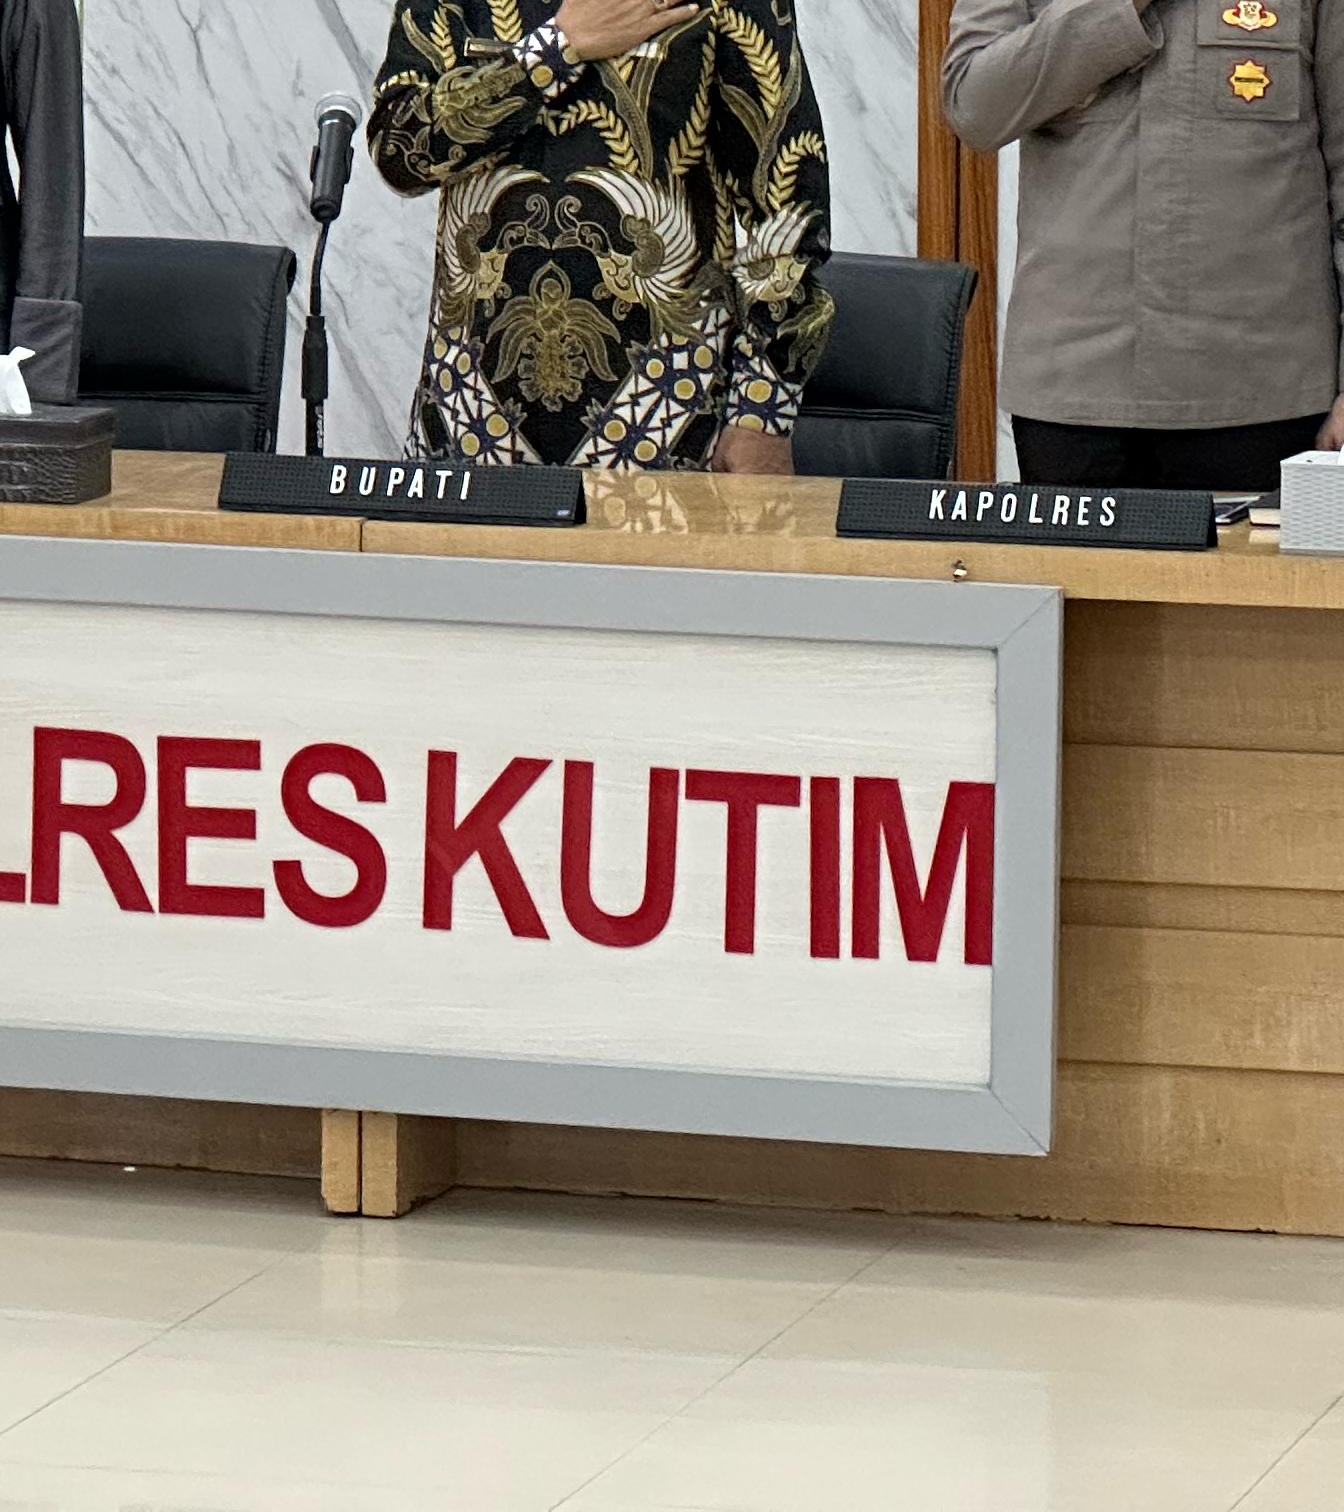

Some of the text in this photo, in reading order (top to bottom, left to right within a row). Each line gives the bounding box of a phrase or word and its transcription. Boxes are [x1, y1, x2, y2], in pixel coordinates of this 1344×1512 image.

[329, 464, 471, 501] BUPATI
[928, 489, 1116, 527] KAPOLRES
[423, 750, 996, 967] KUTIM
